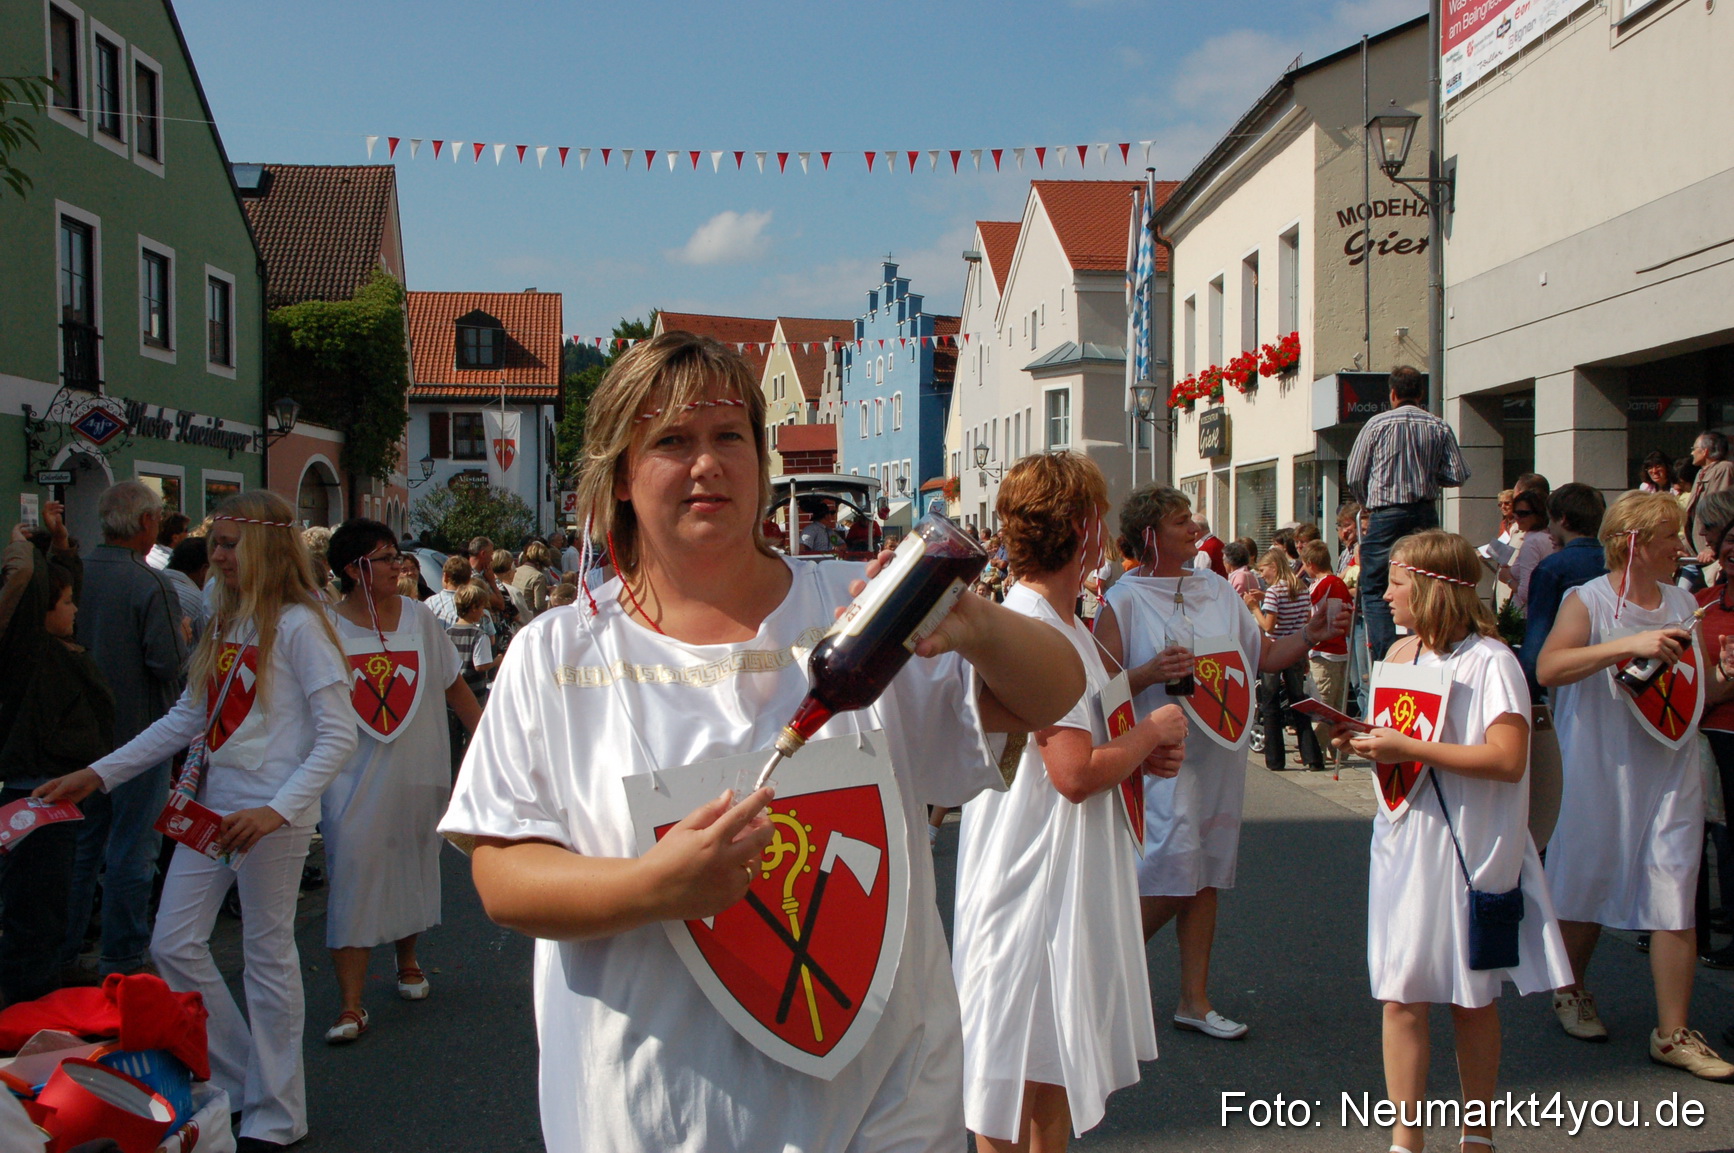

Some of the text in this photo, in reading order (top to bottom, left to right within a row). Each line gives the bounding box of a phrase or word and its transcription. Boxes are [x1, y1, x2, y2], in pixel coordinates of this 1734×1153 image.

[1449, 21, 1462, 39] am
[1336, 199, 1429, 228] MODEHA
[1344, 228, 1429, 266] Gier
[1347, 402, 1378, 412] Mode
[86, 418, 113, 435] Agfa
